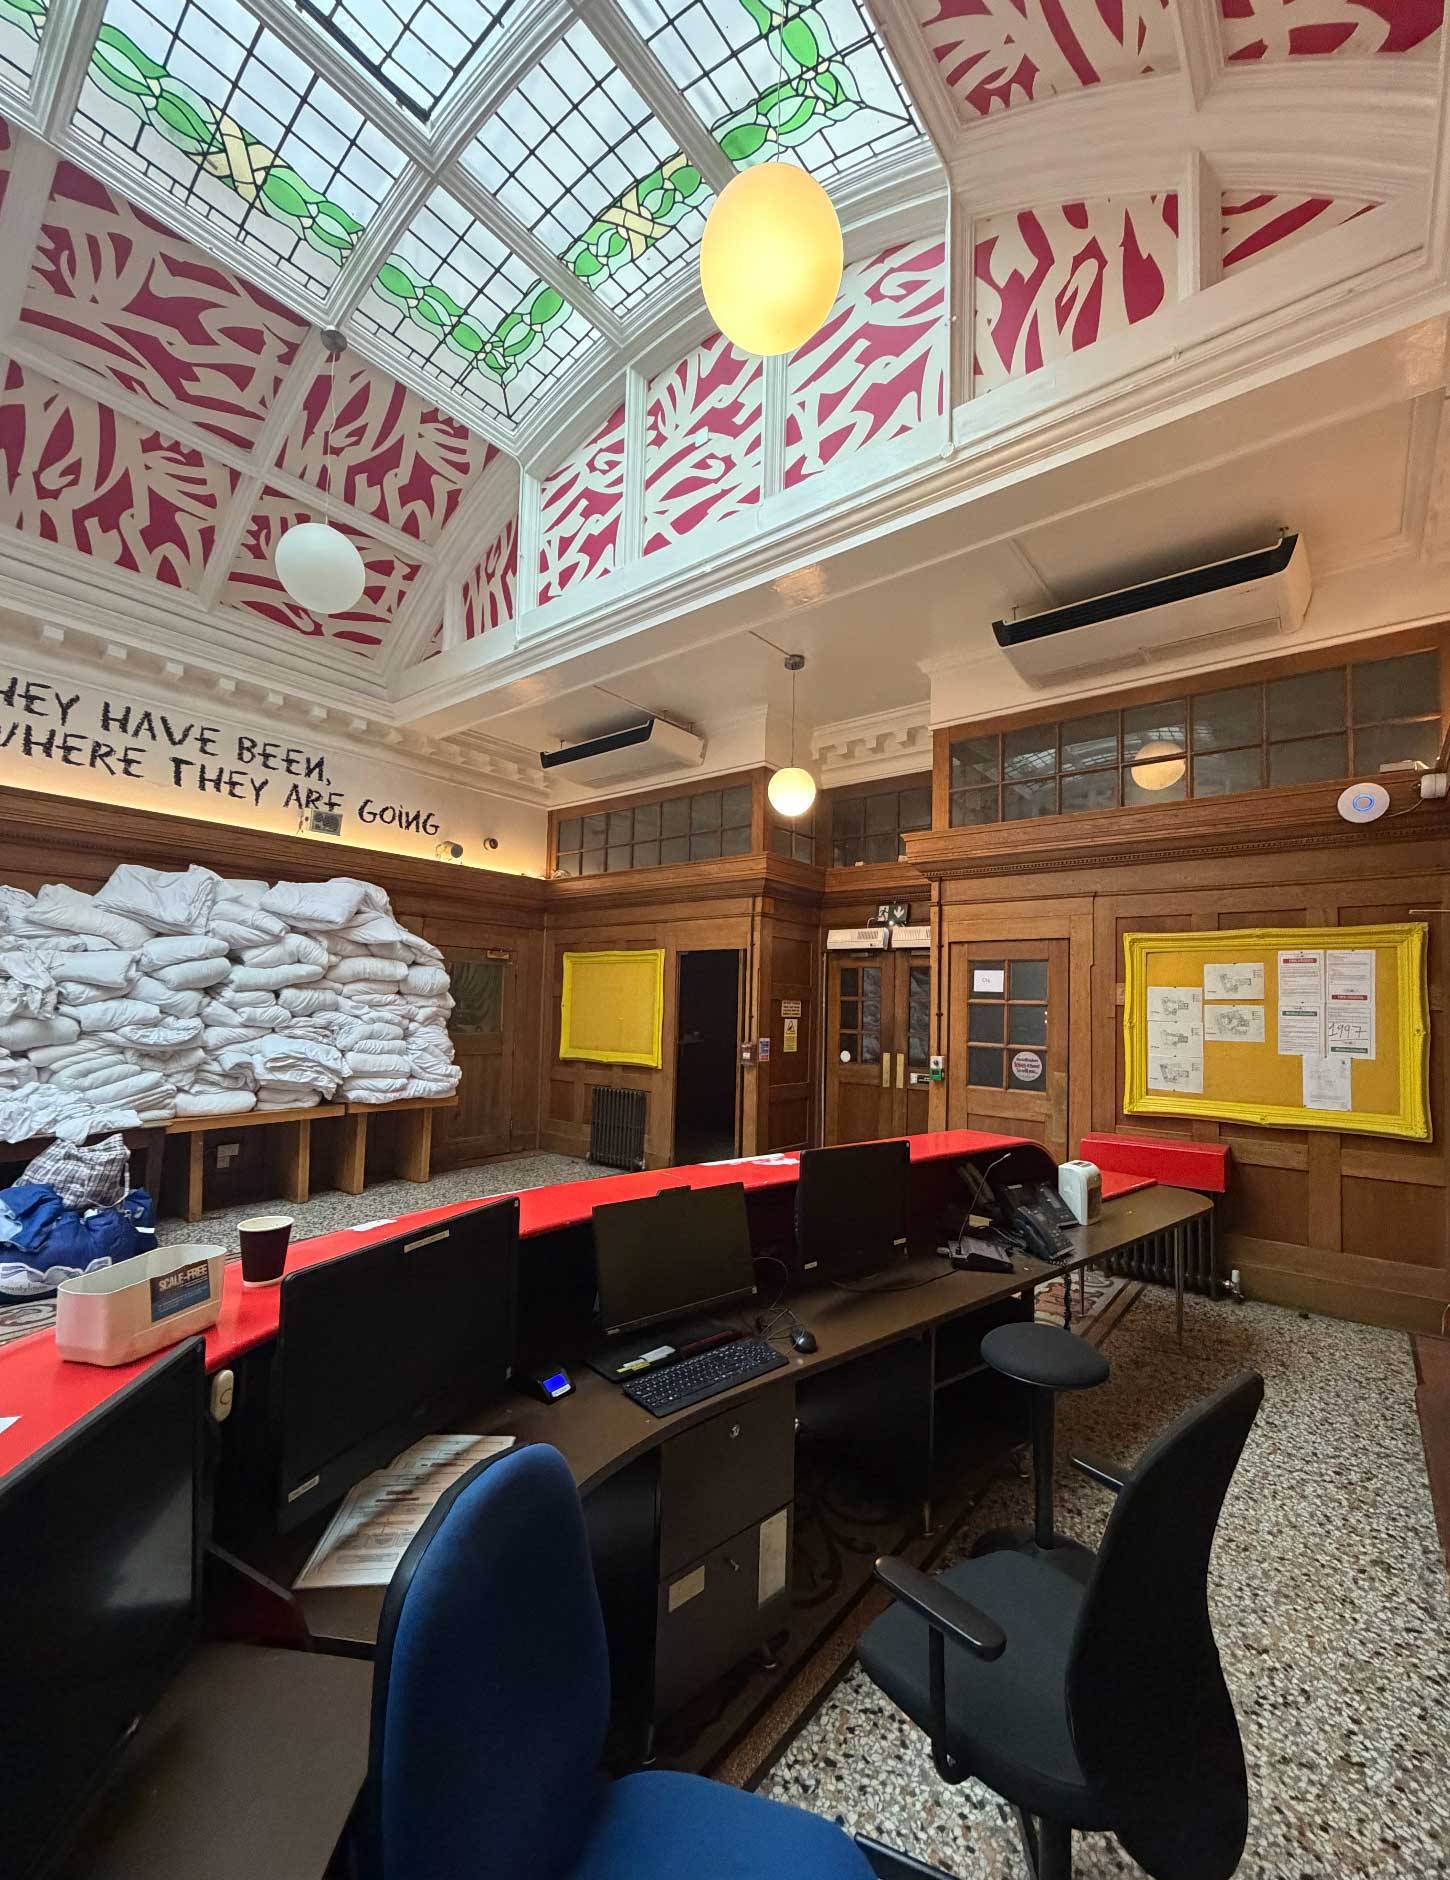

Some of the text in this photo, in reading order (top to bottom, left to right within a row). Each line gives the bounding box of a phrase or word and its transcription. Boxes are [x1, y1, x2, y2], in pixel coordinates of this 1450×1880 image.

[101, 701, 220, 757] HAVE
[237, 736, 332, 786] BEEN,
[170, 756, 269, 807] THEY
[283, 783, 344, 811] ARE
[158, 1264, 208, 1292] SCALE-FREE
